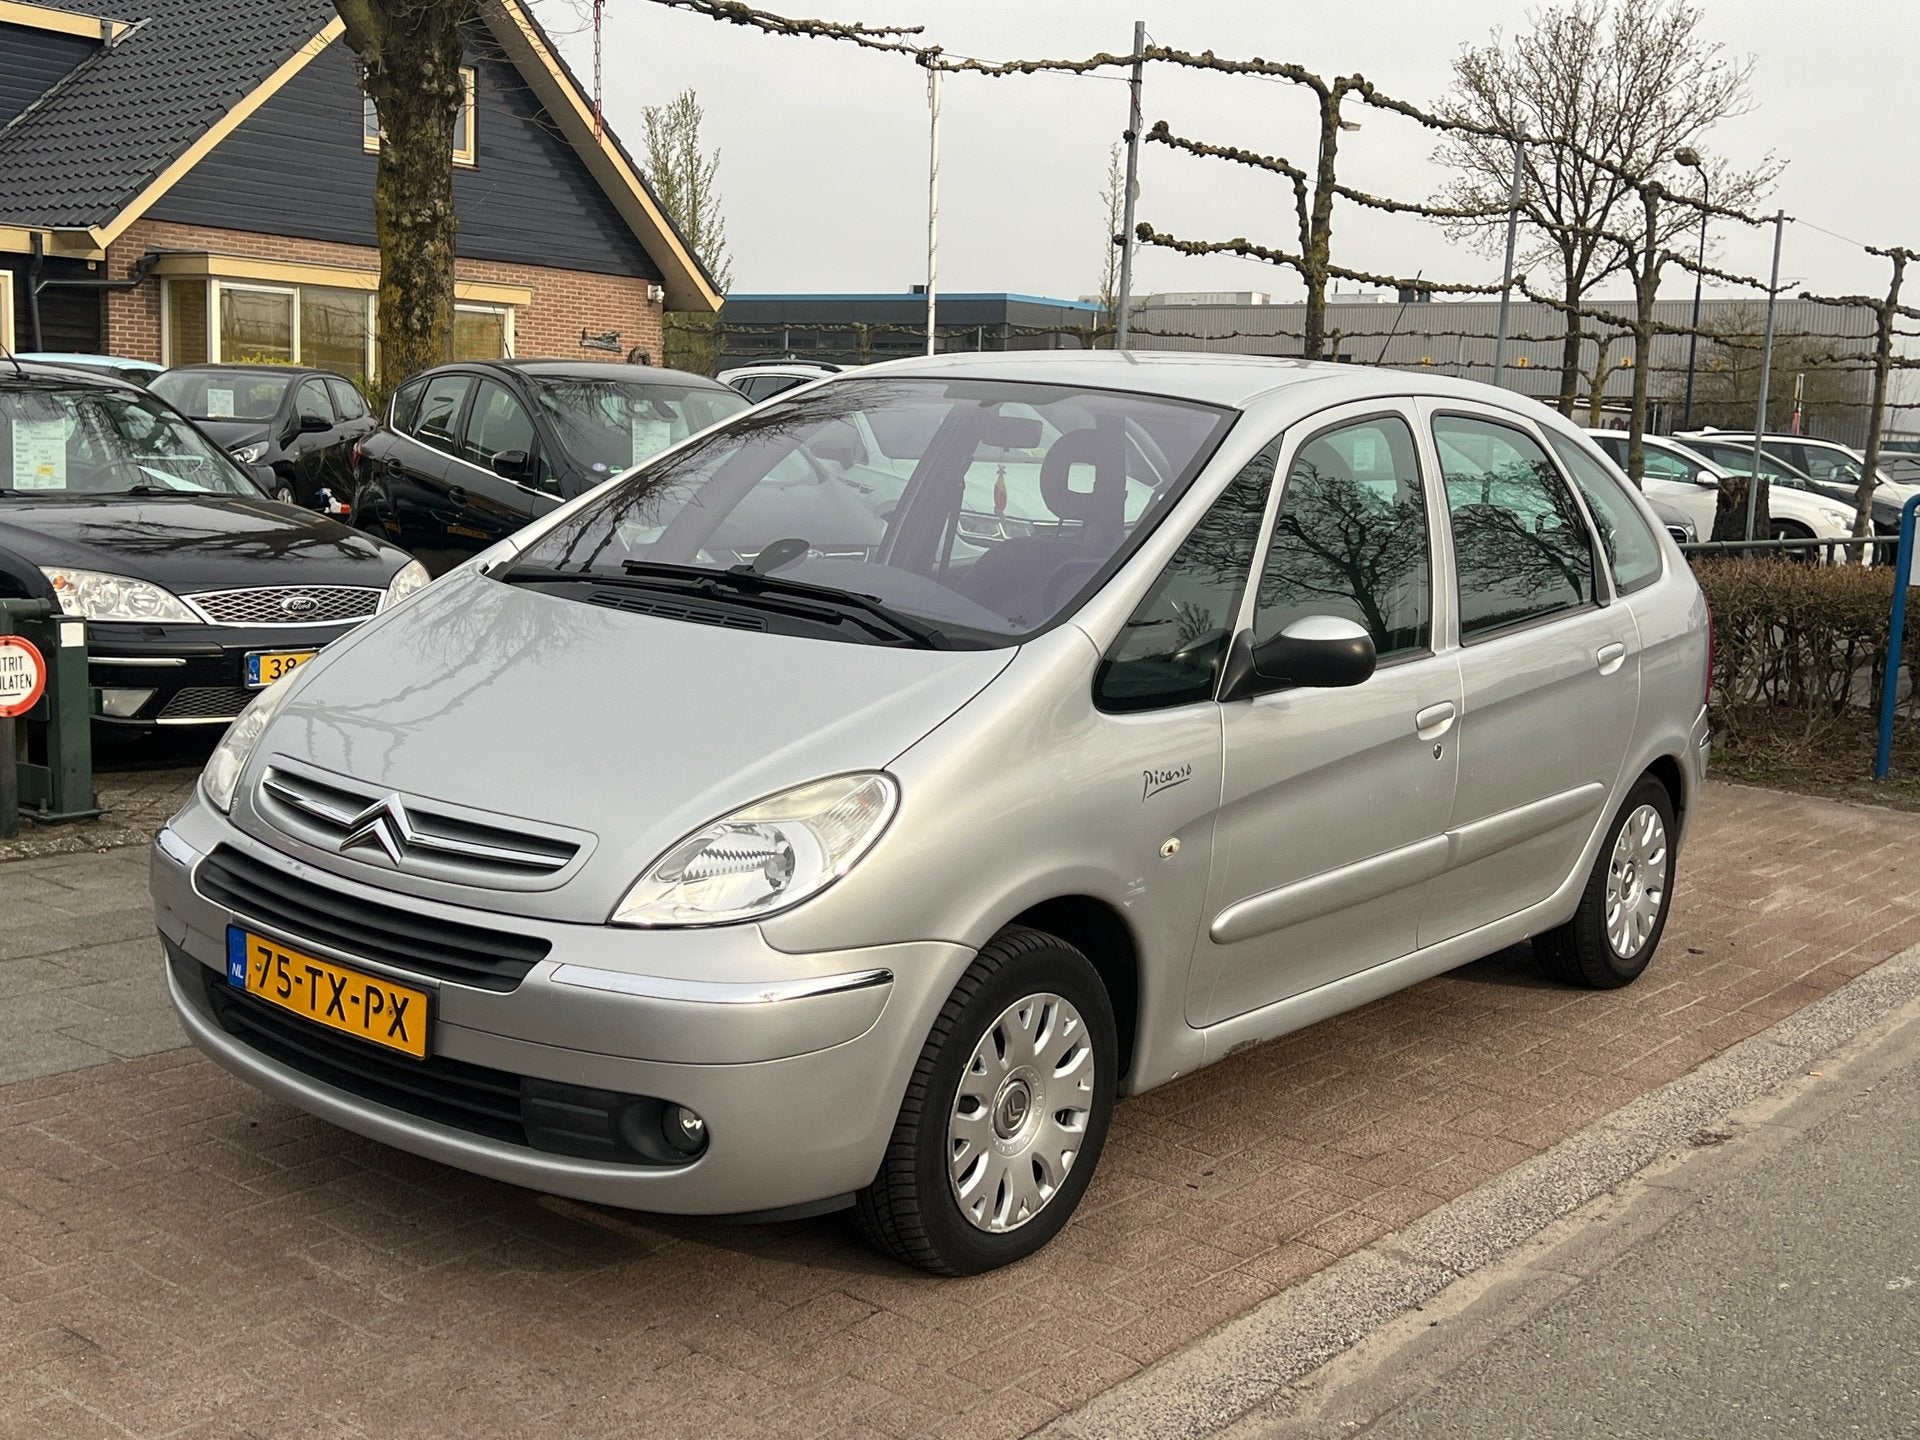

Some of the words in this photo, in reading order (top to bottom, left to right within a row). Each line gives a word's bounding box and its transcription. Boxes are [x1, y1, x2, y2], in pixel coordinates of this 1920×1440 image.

[291, 600, 312, 610] Ford
[0, 655, 24, 672] TRIT
[0, 674, 32, 690] LATEN
[248, 673, 259, 681] NL
[231, 962, 244, 979] NL
[257, 945, 410, 1043] 75-TX-PX
